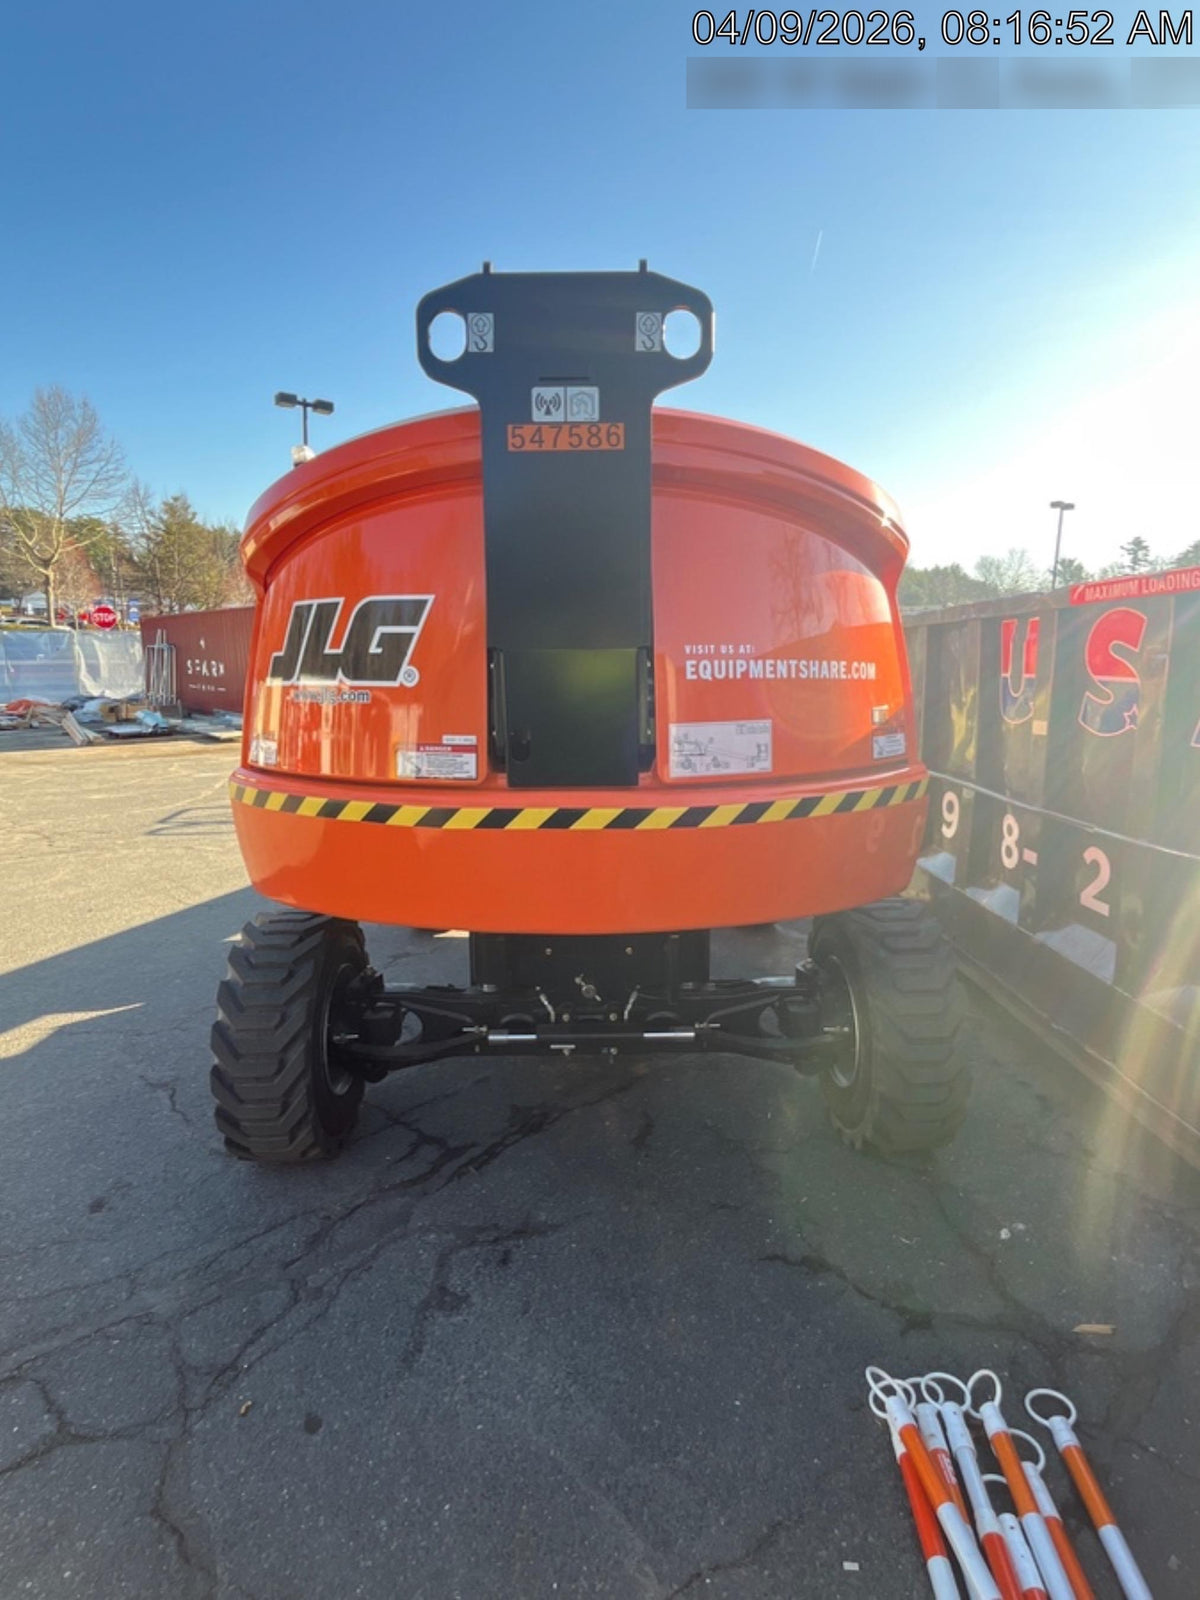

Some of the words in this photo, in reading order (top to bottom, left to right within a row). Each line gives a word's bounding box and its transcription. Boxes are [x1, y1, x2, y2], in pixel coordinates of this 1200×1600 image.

[510, 424, 622, 450] 547586
[1084, 579, 1139, 602] MAXIMUM
[1142, 569, 1200, 594] LOADING
[93, 612, 116, 623] STOP
[267, 595, 435, 687] JLG
[684, 645, 715, 654] VISIT
[720, 645, 734, 654] US
[738, 645, 755, 654] AT:
[685, 660, 876, 681] EQUIPMENTSHARE.COM
